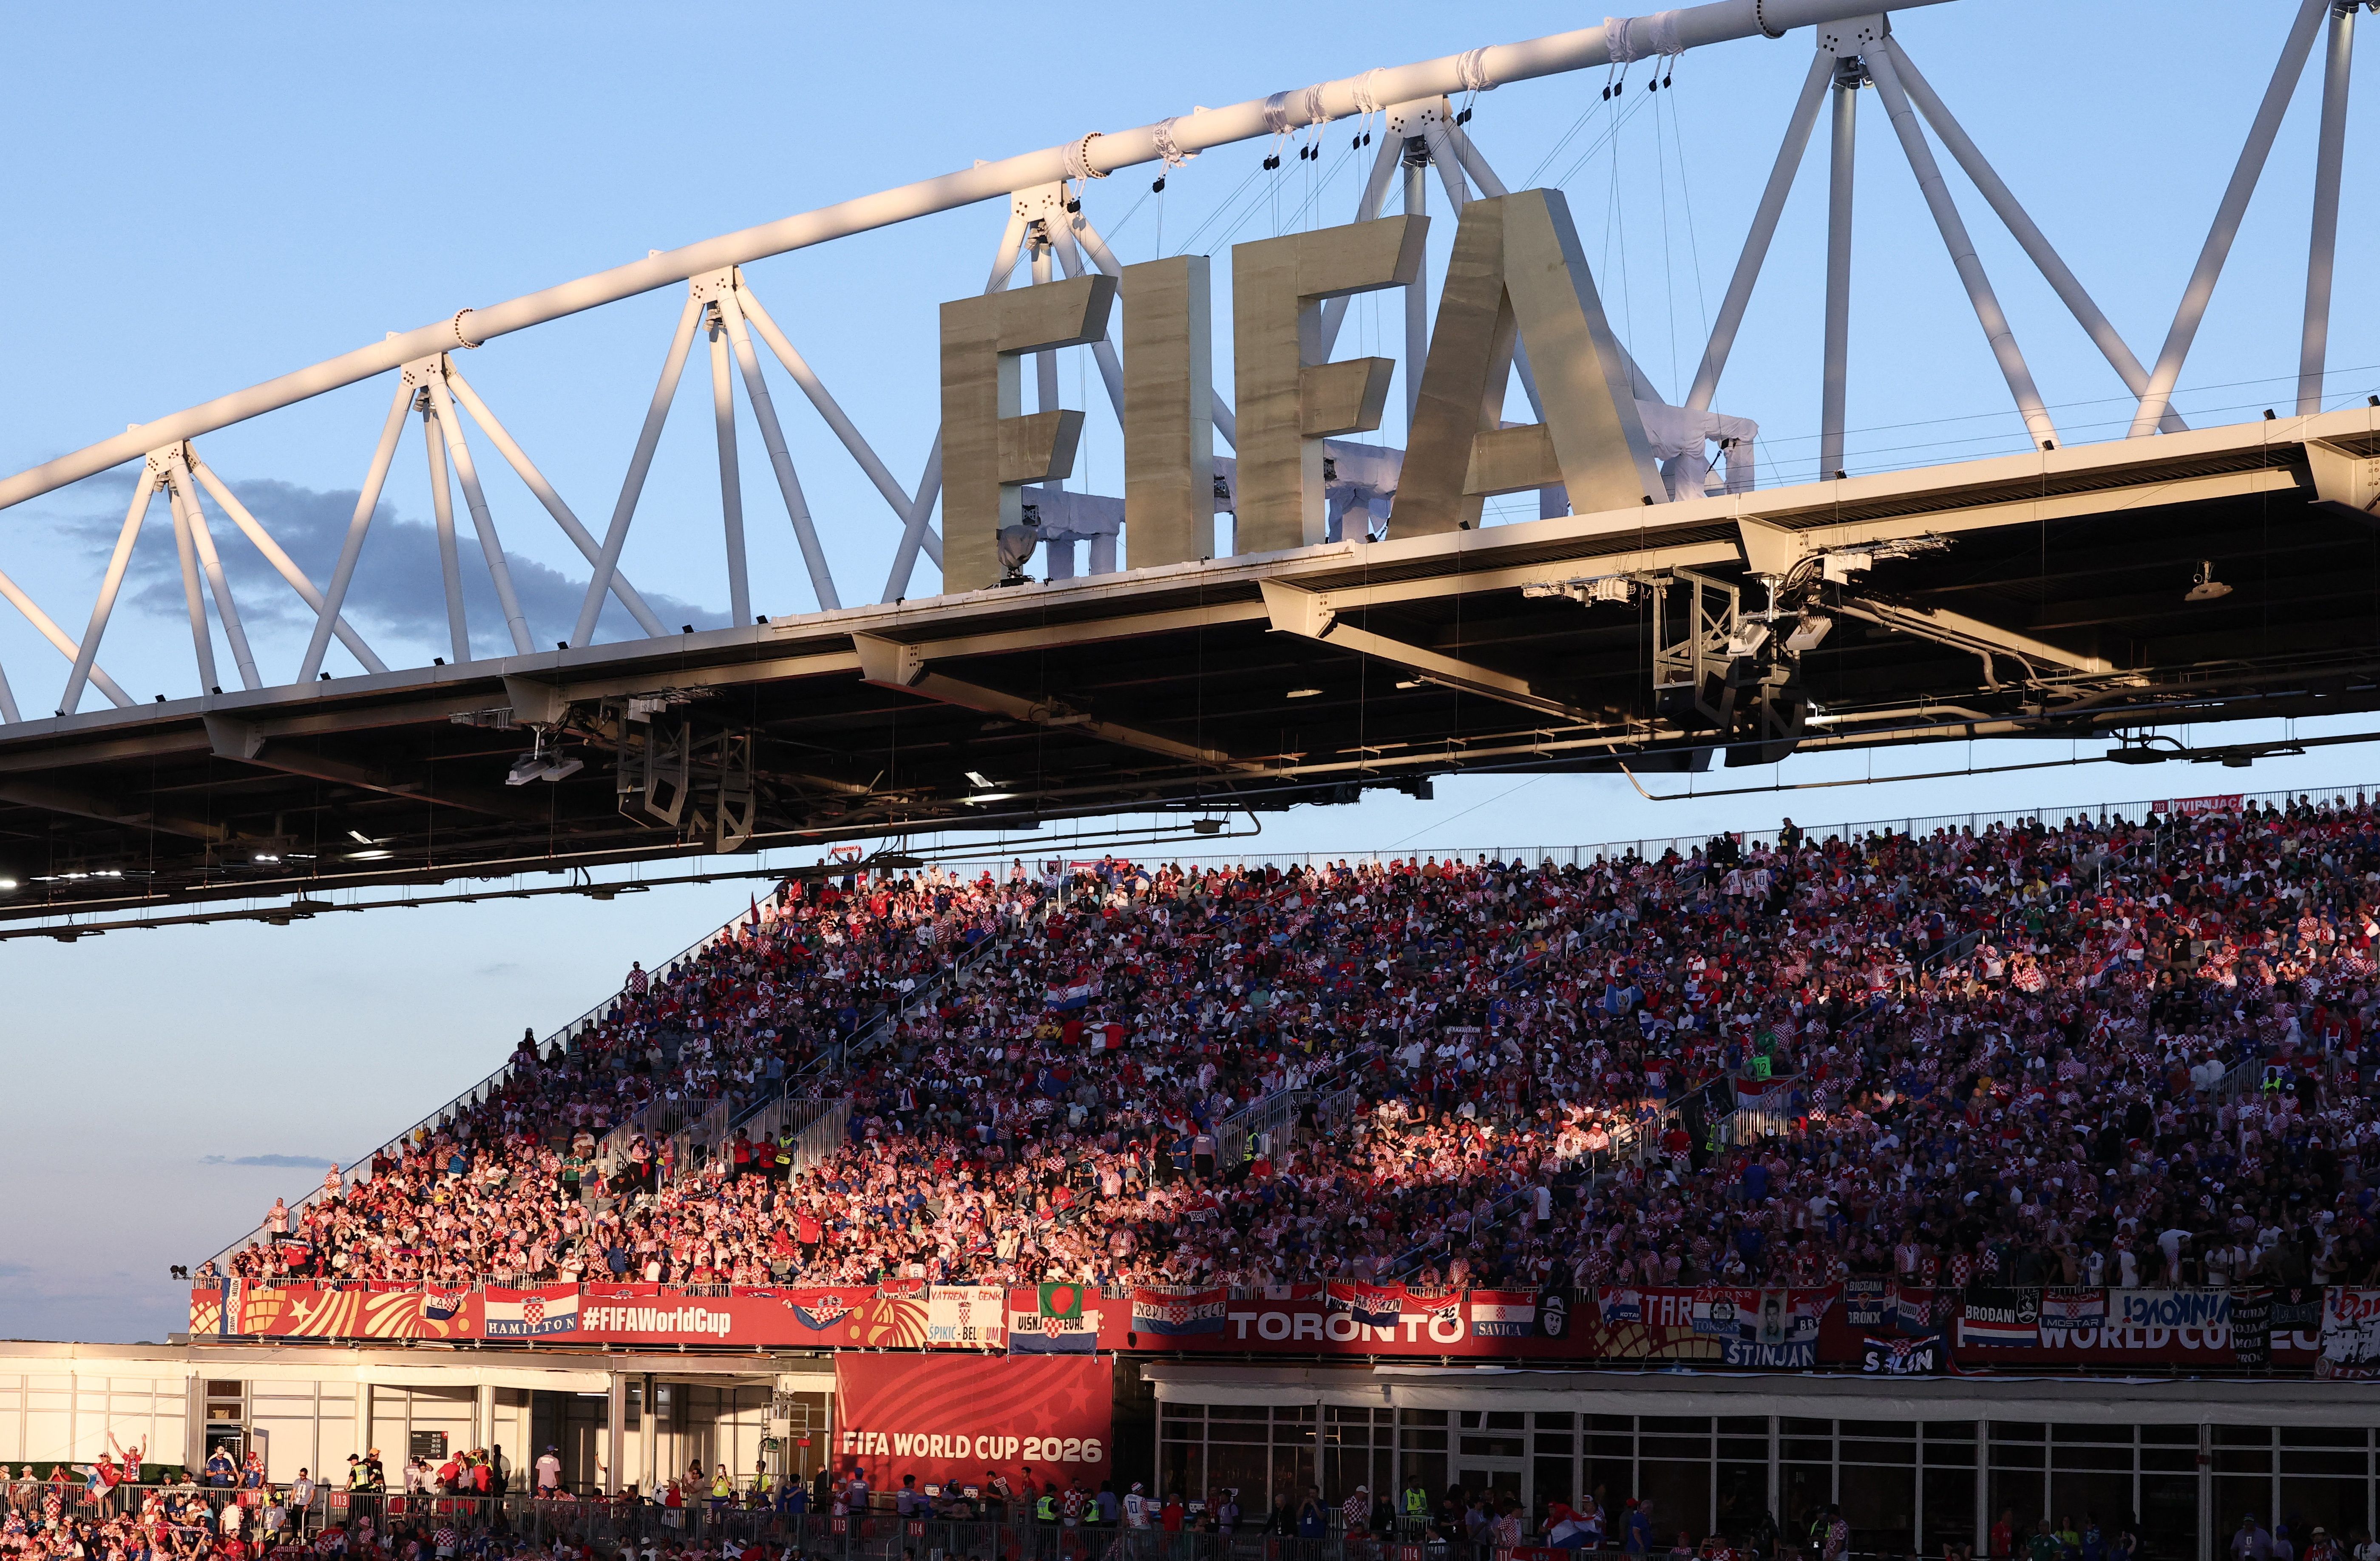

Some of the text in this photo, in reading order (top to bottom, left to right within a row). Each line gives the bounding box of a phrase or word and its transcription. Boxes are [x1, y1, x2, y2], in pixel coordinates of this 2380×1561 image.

[940, 187, 1668, 594] FIFA
[2155, 803, 2164, 812] 213
[1758, 875, 1764, 885] 10
[1757, 1063, 1766, 1074] 12
[1849, 1281, 1883, 1292] BREGANA
[931, 1291, 968, 1300] VATRENI
[978, 1291, 1002, 1300] GENK
[1638, 1294, 1693, 1326] TAR
[488, 1318, 574, 1334] HAMILTON
[582, 1307, 731, 1338] #FIFAWorldCup
[1228, 1312, 1465, 1344] TORONTO
[2047, 1319, 2099, 1328] MOSTAR
[929, 1323, 956, 1340] ŠPIKIĆ
[962, 1326, 999, 1340] BELGIUM
[1479, 1323, 1522, 1337] SAVICA
[2178, 1328, 2235, 1349] CU
[1727, 1340, 1815, 1367] ŠTINJAN
[1863, 1349, 1933, 1374] SLIN
[841, 1431, 1103, 1463] FIFA WORLD CUP 2026
[248, 1493, 261, 1503] 112
[333, 1495, 347, 1506] 113
[1128, 1501, 1138, 1514] 10
[834, 1520, 845, 1531] 113
[911, 1523, 922, 1535] 114
[1404, 1548, 1417, 1561] 114
[1499, 1551, 1507, 1561] 11
